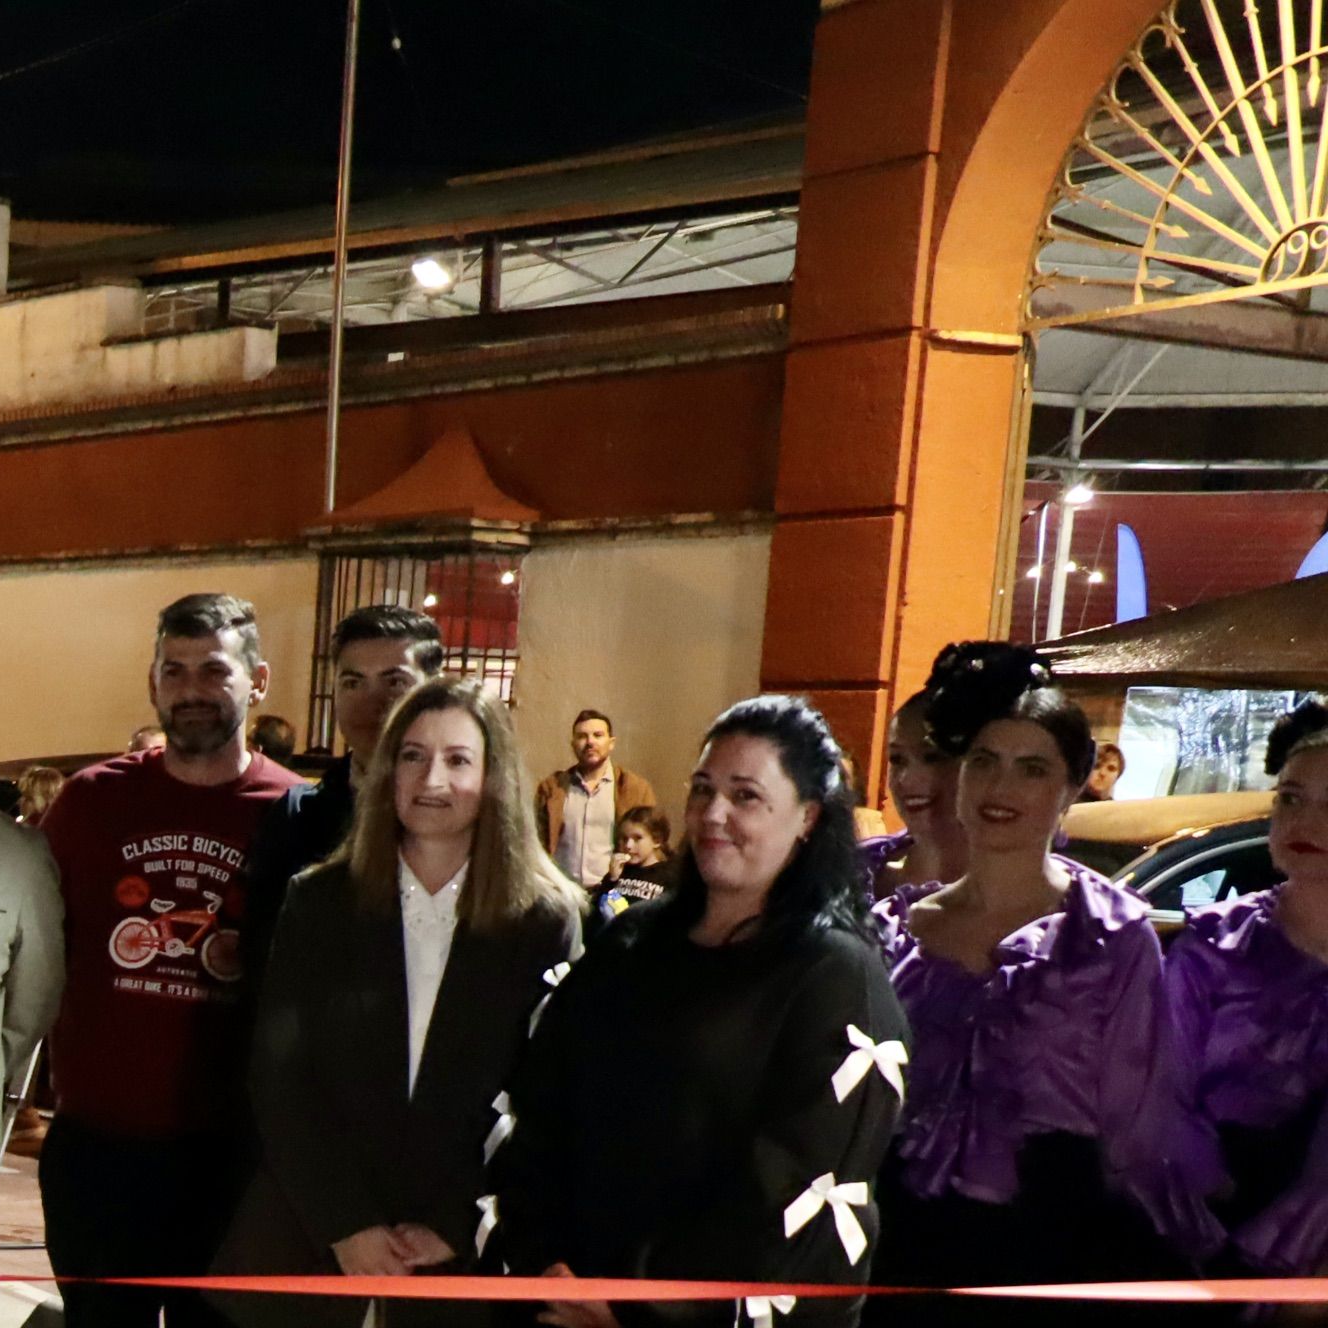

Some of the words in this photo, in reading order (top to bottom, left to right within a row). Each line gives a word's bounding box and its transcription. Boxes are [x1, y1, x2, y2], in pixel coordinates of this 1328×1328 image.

[122, 835, 188, 860] CLASSIC
[174, 859, 195, 871] FOR
[197, 862, 230, 883] SPEED
